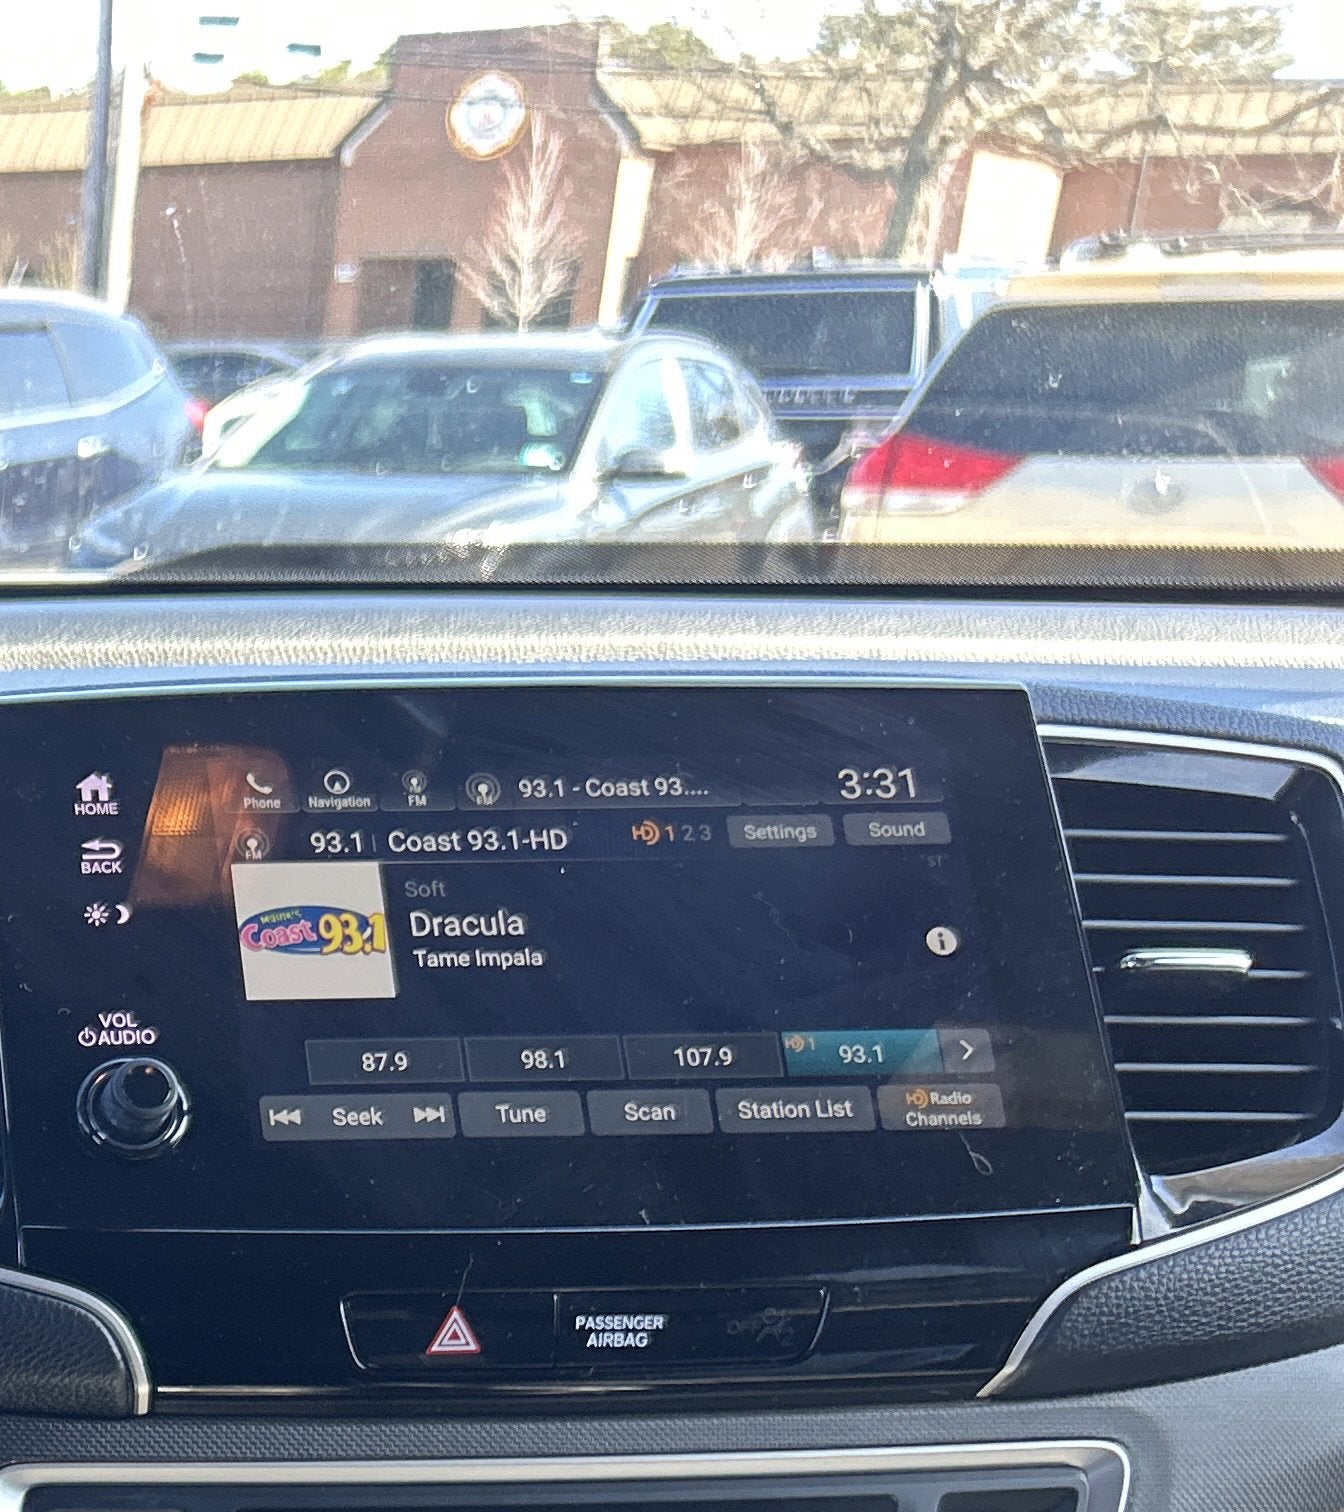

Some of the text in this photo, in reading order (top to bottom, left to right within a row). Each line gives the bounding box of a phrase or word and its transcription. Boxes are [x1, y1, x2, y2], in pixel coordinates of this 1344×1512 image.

[518, 778, 566, 798] 93.1
[585, 777, 649, 797] Coast
[837, 768, 917, 799] 3:31
[74, 802, 119, 816] HOME
[243, 796, 281, 809] Phone
[308, 796, 371, 811] Navigation
[408, 795, 427, 807] FM
[743, 821, 817, 844] Settings
[868, 821, 926, 838] Sound
[310, 827, 568, 853] 93.1 Coast 93.1-HD
[80, 860, 123, 874] BACK
[404, 880, 447, 898] Soft
[409, 909, 526, 937] Dracula
[240, 911, 388, 955] Coast 93.1
[413, 947, 544, 971] Tame Impala
[98, 1014, 139, 1028] VOL
[97, 1028, 156, 1046] AUDIO
[361, 1052, 409, 1071] 87.9
[520, 1049, 566, 1069] 98.1
[673, 1046, 733, 1067] 107.9
[838, 1044, 884, 1064] 93.1
[930, 1091, 973, 1106] Radio
[332, 1107, 383, 1126] Seek
[495, 1103, 547, 1124] Tune
[623, 1102, 676, 1122] Scan
[737, 1098, 855, 1120] Station List
[905, 1110, 983, 1127] Channels
[576, 1314, 664, 1331] PASSENGER
[586, 1331, 649, 1349] AIRBAG
